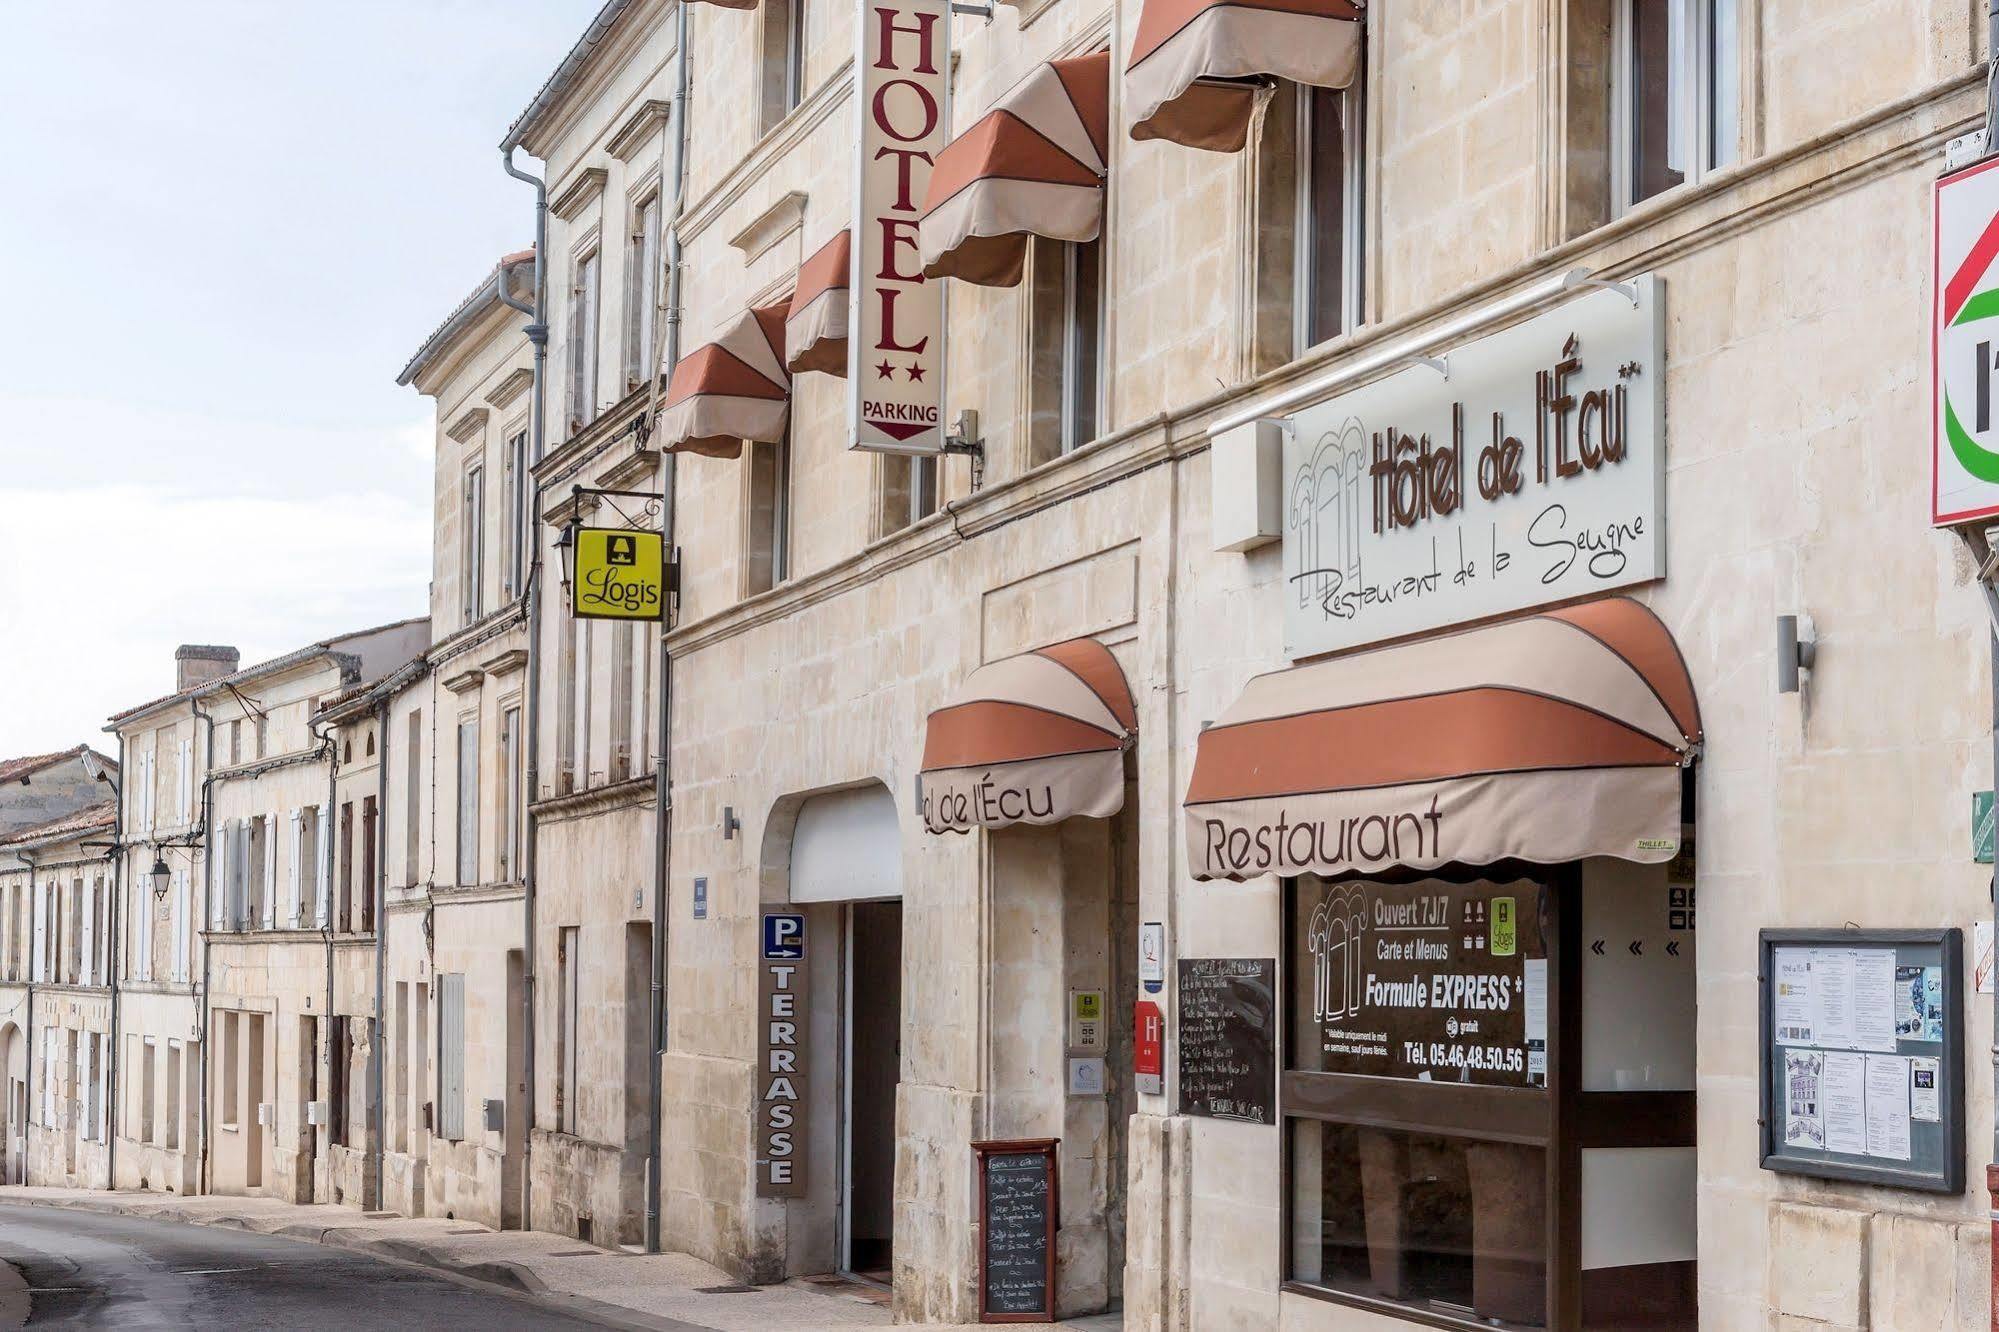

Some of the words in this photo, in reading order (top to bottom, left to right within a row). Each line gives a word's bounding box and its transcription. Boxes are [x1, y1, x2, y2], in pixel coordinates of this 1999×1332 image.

[872, 6, 940, 355] HOTEL
[862, 400, 938, 423] PARKING
[1369, 401, 1464, 536] Hôtel
[1477, 411, 1524, 502] de
[1535, 331, 1628, 485] l'Écu
[1289, 535, 1442, 622] Restaurant
[1453, 526, 1475, 587] de
[1492, 522, 1511, 580] la
[1527, 503, 1644, 585] Seugne
[582, 567, 658, 612] Logis
[940, 785, 968, 824] de
[1204, 794, 1443, 871] Restaurant
[1374, 898, 1418, 926] Ouvert
[775, 919, 798, 946] P
[1376, 938, 1402, 961] Carte
[1403, 941, 1414, 960] et
[1415, 937, 1449, 961] Menus
[1365, 973, 1427, 1008] Formule
[1431, 974, 1511, 1011] EXPRESS
[1145, 1015, 1158, 1042] H
[764, 965, 799, 1184] TERRASSE
[1404, 1041, 1427, 1065] Tél.
[1430, 1042, 1523, 1072] 05.46.48.50.56
